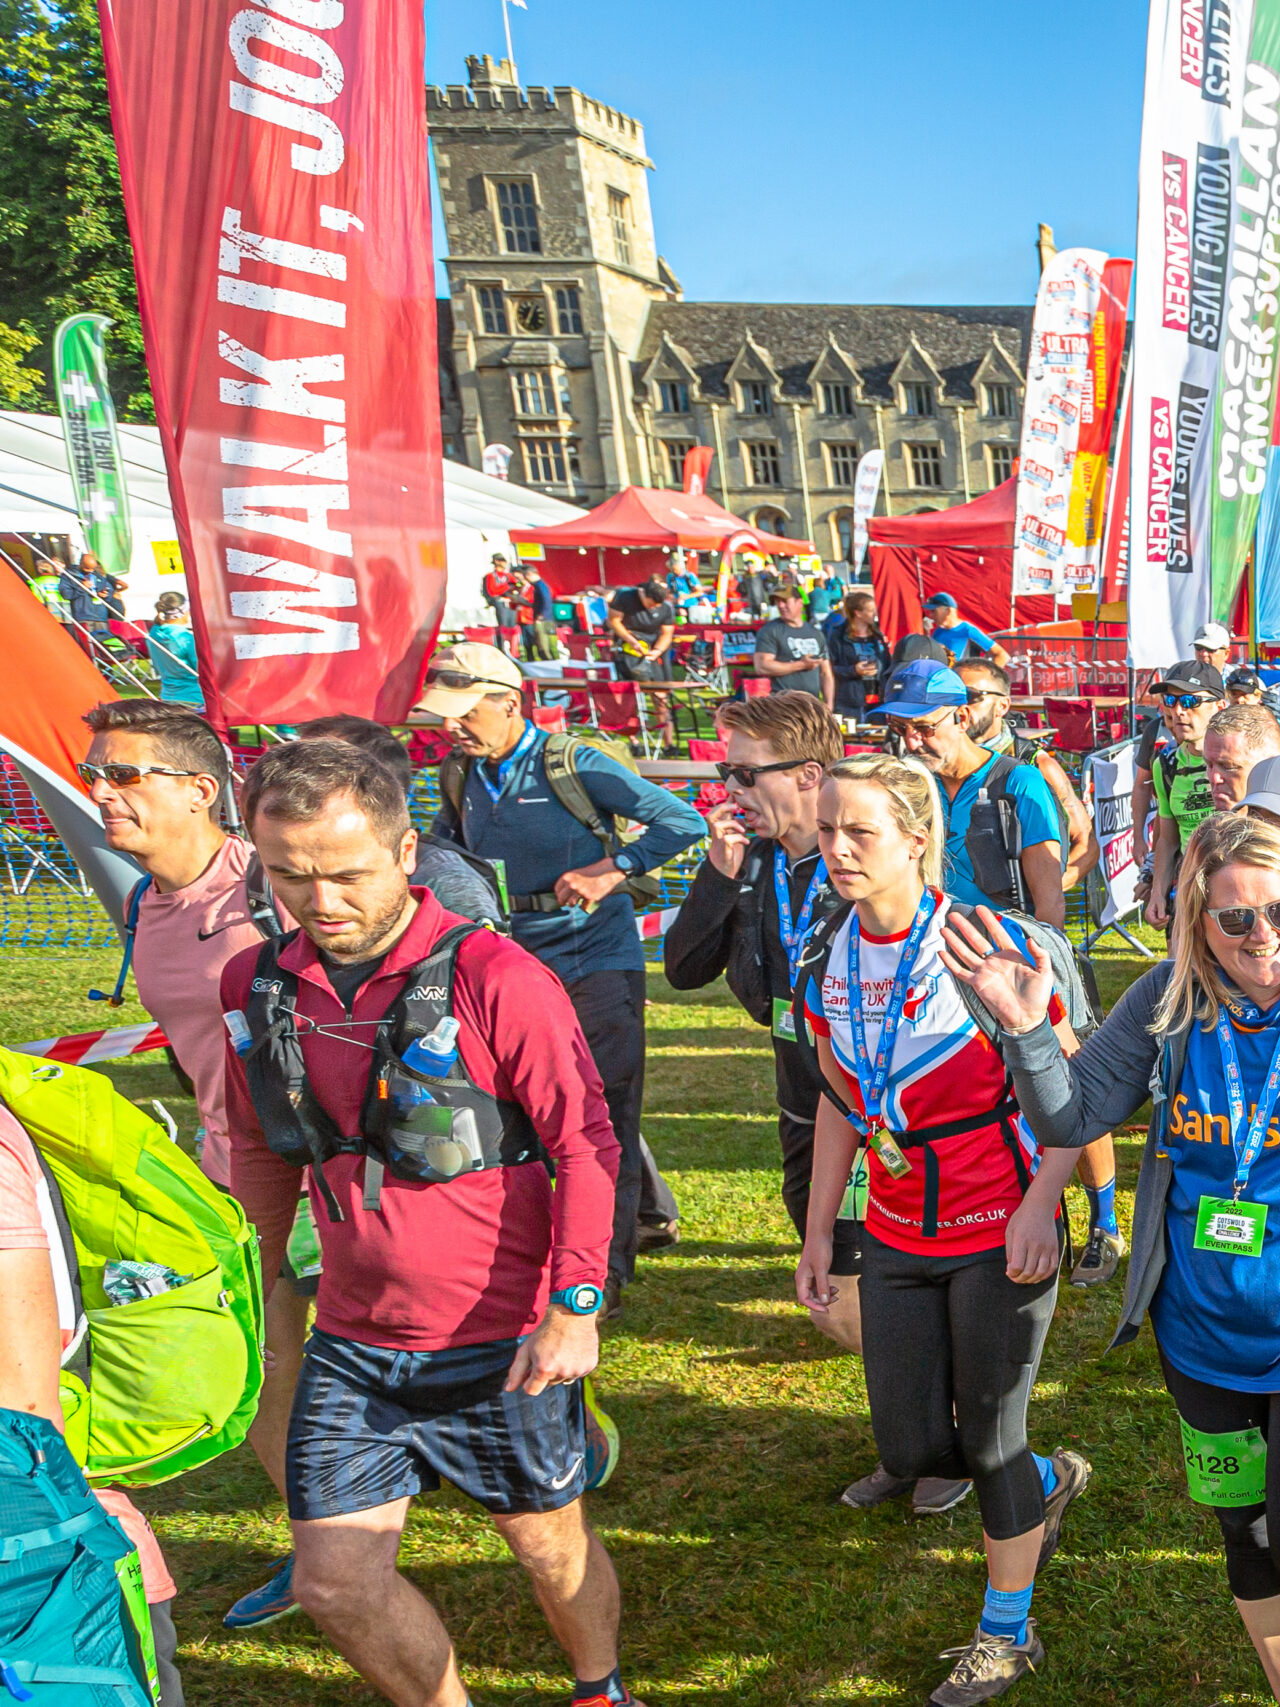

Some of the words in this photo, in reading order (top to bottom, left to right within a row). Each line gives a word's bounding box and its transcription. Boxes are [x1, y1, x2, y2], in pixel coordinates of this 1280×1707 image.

[1181, 0, 1203, 86] NCER
[1205, 8, 1231, 100] LIVES
[1194, 156, 1230, 256] YOUNG
[217, 205, 365, 328] IT,
[1164, 204, 1190, 326] CANCER
[1218, 62, 1280, 499] MACMILLAN
[1187, 258, 1223, 344] LIVES
[1045, 333, 1089, 353] ULTRA
[1094, 348, 1107, 410] YOURSELF
[1238, 323, 1276, 495] CANCER
[67, 410, 97, 486] WELFARE
[94, 429, 117, 472] AREA
[217, 329, 360, 660] WALK
[1146, 446, 1173, 557] CANCER
[1022, 515, 1067, 547] ULTRA
[1166, 489, 1192, 568] LIVES
[724, 632, 757, 645] LTRA
[910, 929, 920, 943] 2022
[823, 974, 871, 991] Chilen
[867, 993, 887, 1006] UK
[874, 1071, 884, 1085] 2022
[1250, 1131, 1261, 1148] 2022
[1217, 1217, 1246, 1228] COTSWOLD
[1225, 1207, 1243, 1216] 2022
[1205, 1239, 1231, 1250] EVENT
[1232, 1242, 1254, 1253] PASS
[1185, 1445, 1240, 1475] 2128
[1211, 1490, 1227, 1499] Full
[1229, 1491, 1254, 1499] Cont.
